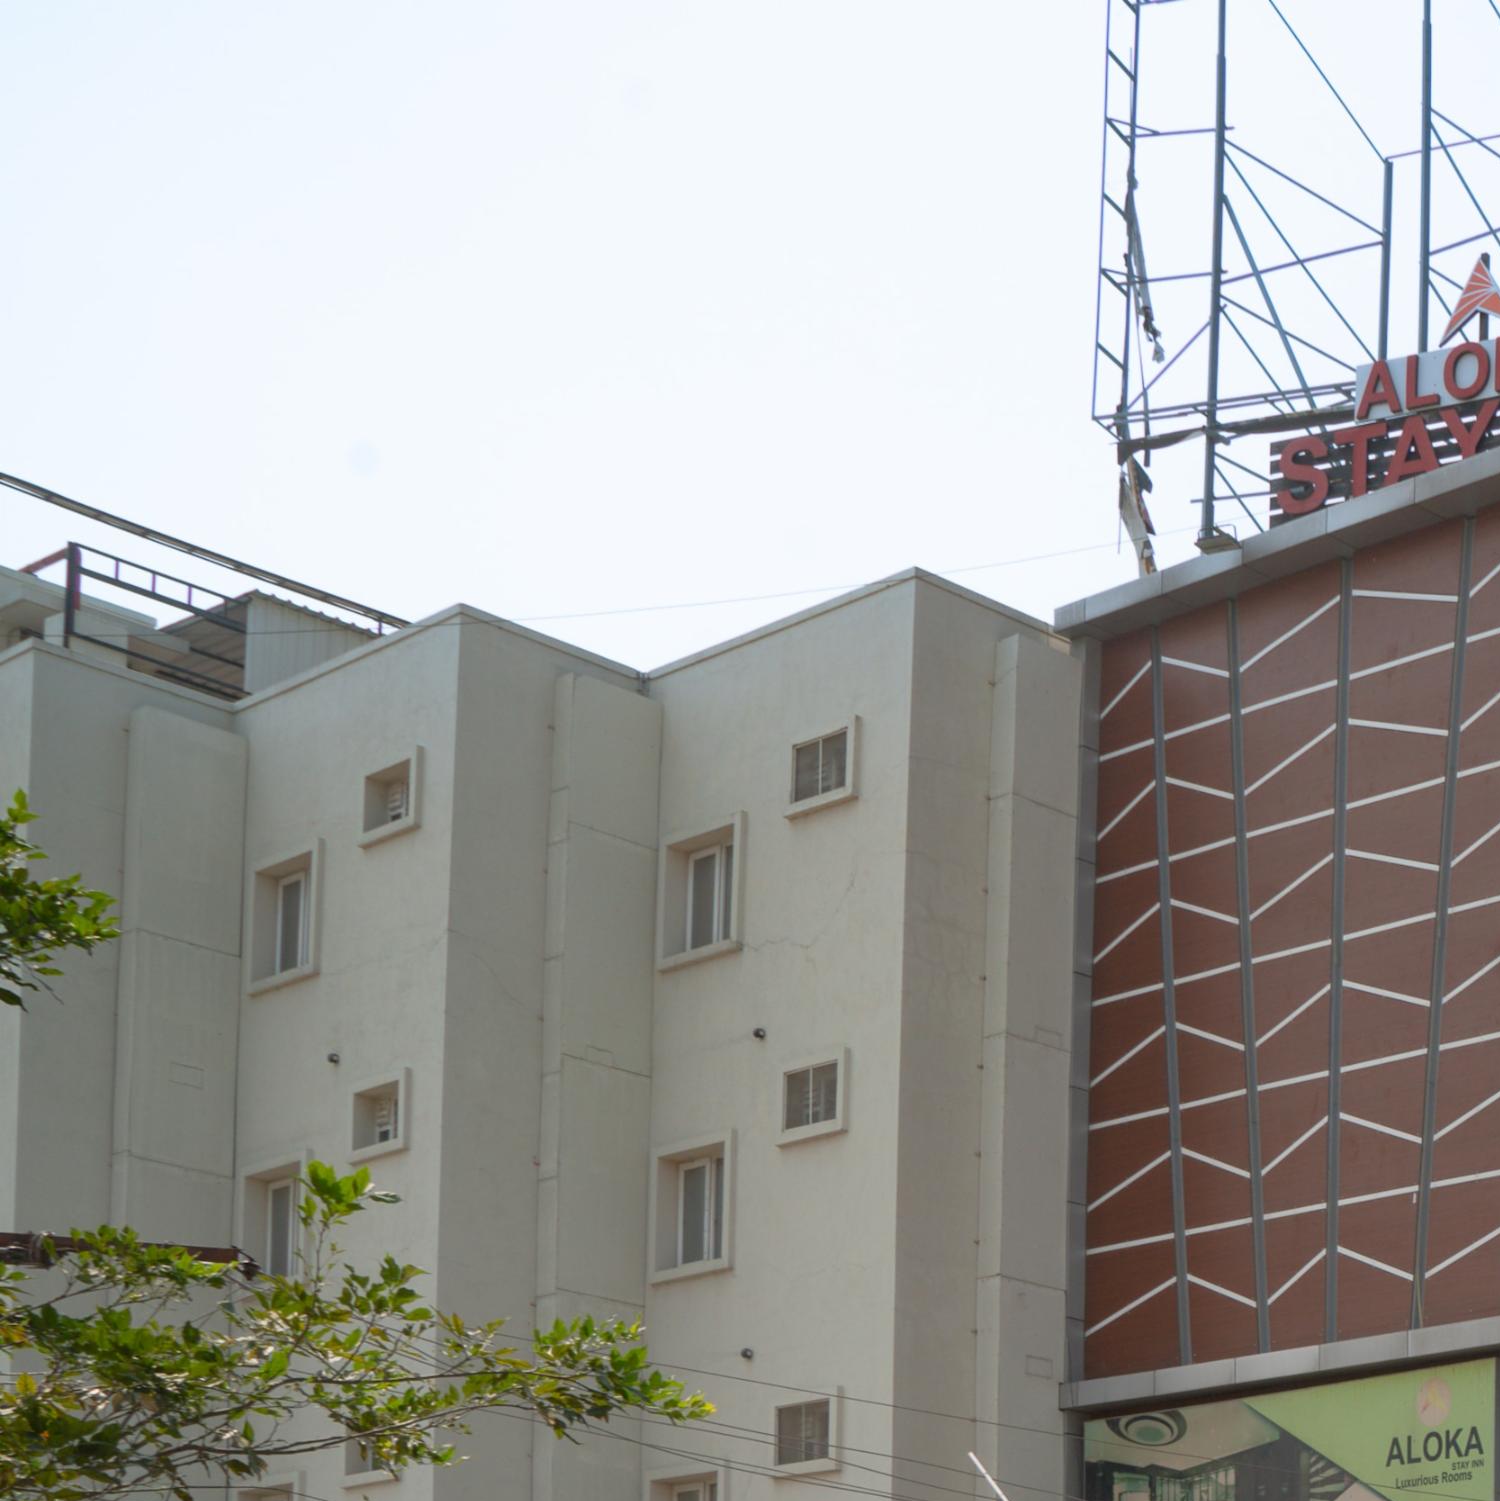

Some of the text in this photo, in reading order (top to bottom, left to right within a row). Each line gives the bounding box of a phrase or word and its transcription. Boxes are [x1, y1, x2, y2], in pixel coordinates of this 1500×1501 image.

[1276, 400, 1500, 515] STAY
[1385, 1426, 1484, 1467] ALOKA
[1451, 1459, 1485, 1471] STAY INN
[1395, 1471, 1472, 1489] Luxurious Rooms
